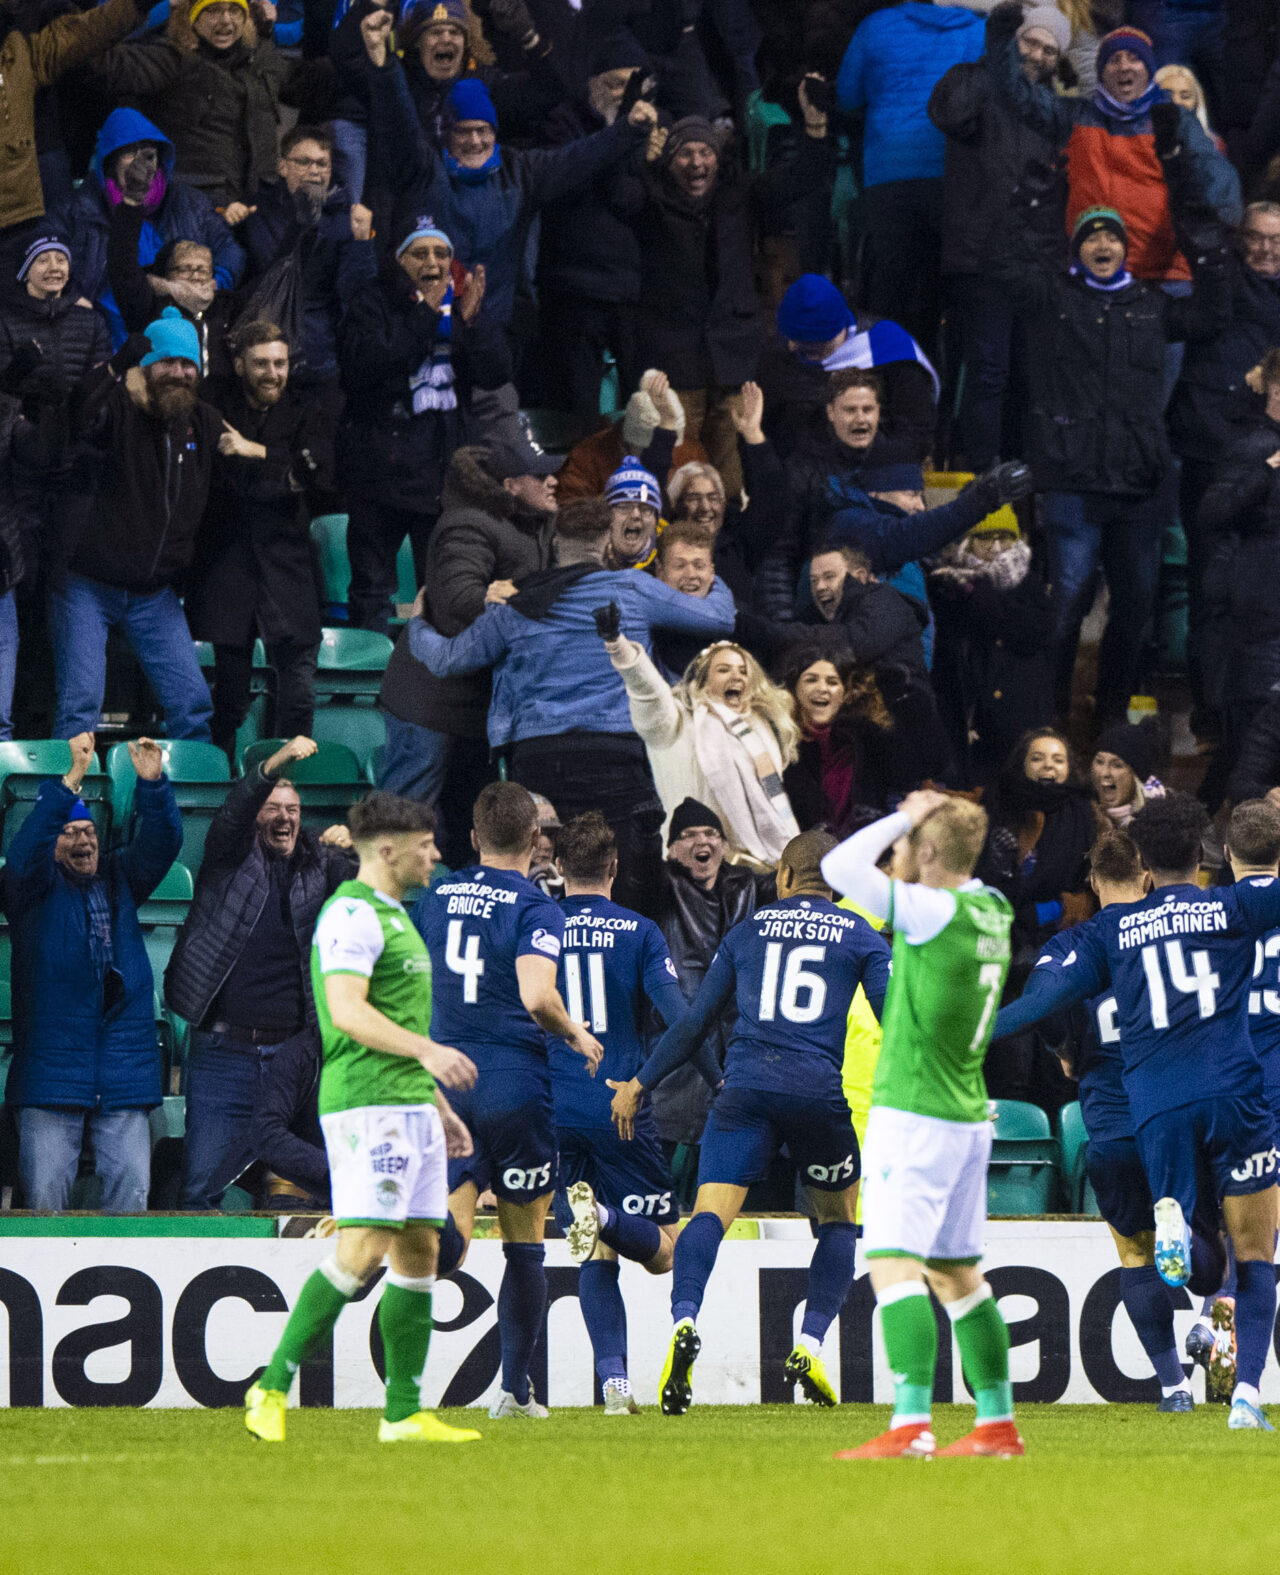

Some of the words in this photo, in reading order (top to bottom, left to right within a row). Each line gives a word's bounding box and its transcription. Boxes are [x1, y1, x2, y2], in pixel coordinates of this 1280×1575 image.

[447, 895, 495, 919] BRUCE
[754, 909, 855, 929] QTSGROUP.COM
[1119, 901, 1223, 930] QTSGROUP.COM
[563, 929, 614, 948] ILLAR
[759, 921, 843, 943] JACKSON
[1118, 911, 1227, 950] HAMALAINEN
[445, 919, 484, 1004] 4
[564, 952, 607, 1034] 11
[759, 941, 827, 1024] 16
[1141, 938, 1220, 1029] 14
[968, 963, 1002, 1052] 7
[503, 1162, 551, 1190] QTS
[807, 1154, 854, 1183] QTS
[1231, 1147, 1276, 1182] QTS
[622, 1192, 671, 1216] QTS
